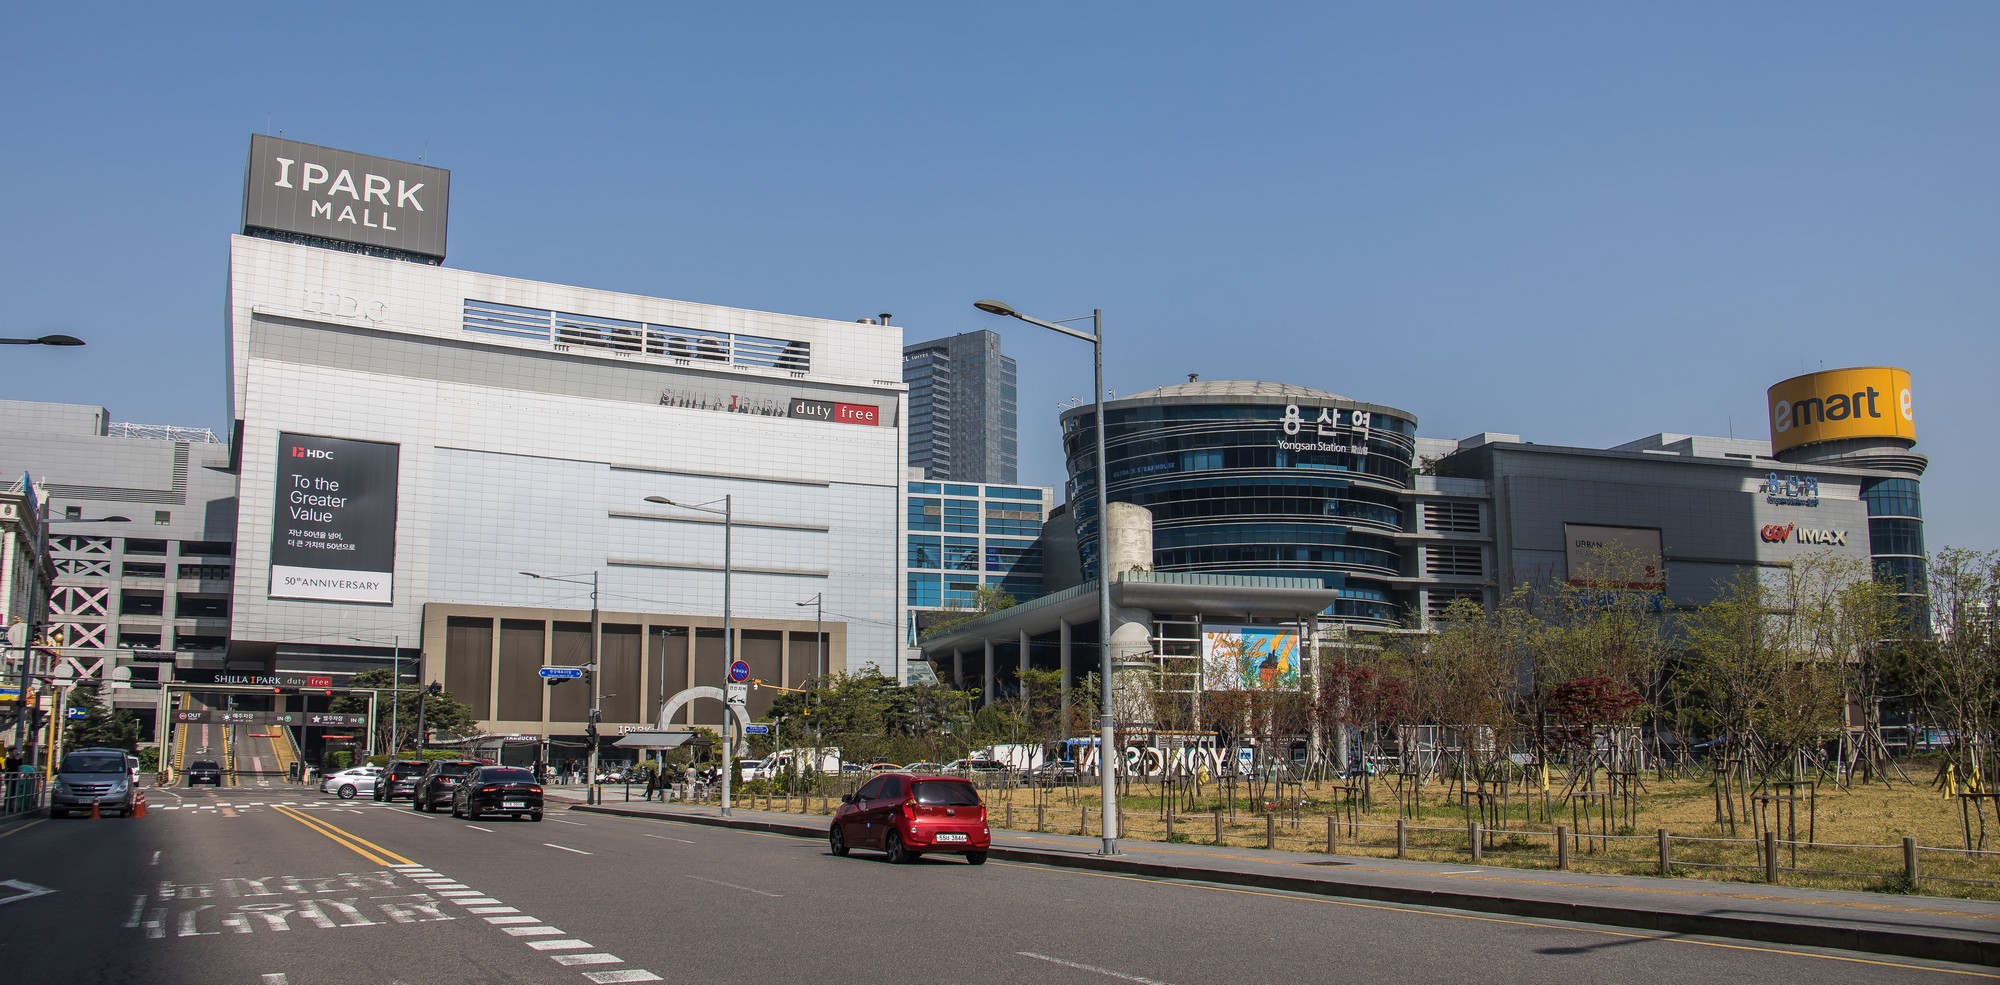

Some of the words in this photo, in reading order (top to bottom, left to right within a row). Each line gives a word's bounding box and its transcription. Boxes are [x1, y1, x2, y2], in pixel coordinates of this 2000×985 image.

[274, 157, 425, 212] IPARK
[311, 199, 397, 231] MALL
[661, 388, 725, 408] SHILLA
[796, 402, 831, 419] duty
[840, 405, 873, 420] free
[1774, 386, 1881, 433] emart
[1279, 404, 1371, 440] 용산역
[306, 449, 334, 460] HDC
[1278, 440, 1317, 453] Yongsan
[1317, 441, 1347, 452] Station
[292, 474, 311, 488] To
[314, 477, 339, 491] the
[290, 490, 347, 508] Greater
[289, 506, 333, 523] Value
[288, 528, 302, 537] 지난
[303, 530, 326, 539] 50년을
[1762, 521, 1795, 542] CGV
[1797, 527, 1847, 545] IMAX
[287, 539, 295, 547] 더
[326, 543, 356, 551] 50년으로
[1575, 539, 1603, 548] URBAN
[214, 674, 249, 684] SHILLA
[250, 676, 281, 685] IPARK
[287, 677, 307, 687] duty
[310, 678, 329, 686] free
